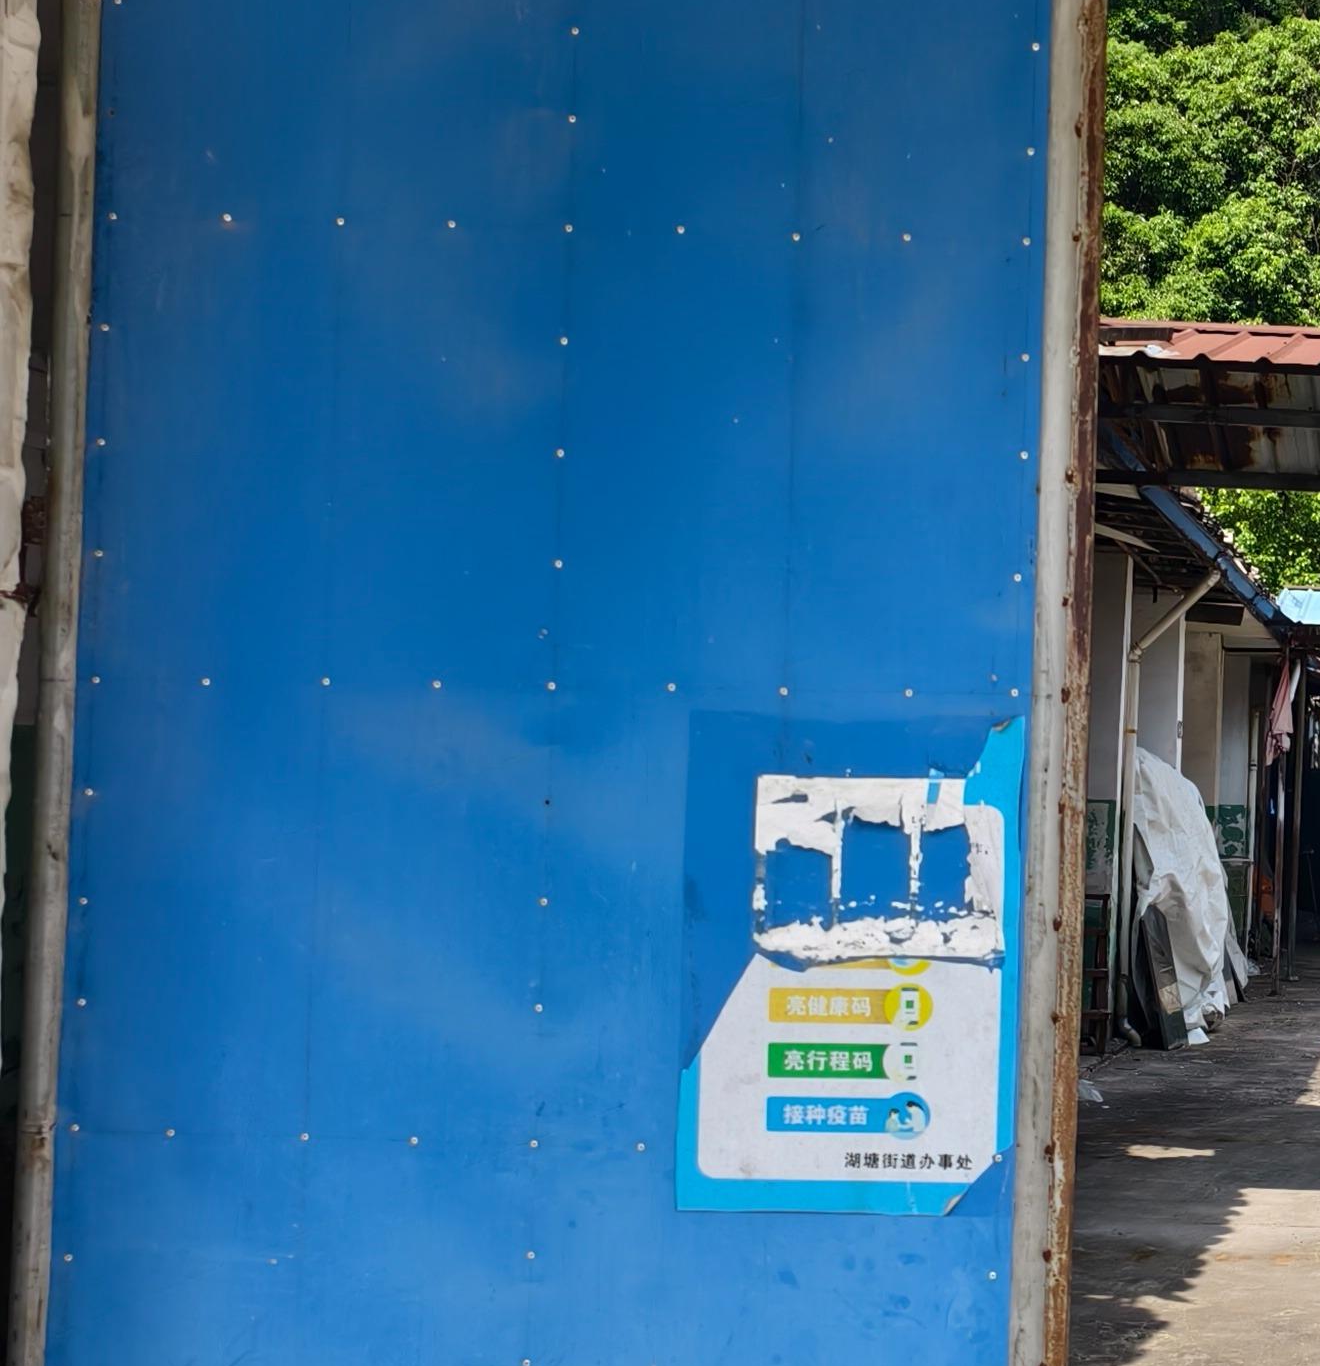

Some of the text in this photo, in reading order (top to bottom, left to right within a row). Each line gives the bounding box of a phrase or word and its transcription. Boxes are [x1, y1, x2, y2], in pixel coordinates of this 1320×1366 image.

[786, 994, 872, 1018] 亮健康码
[783, 1049, 874, 1073] 亮行程码
[782, 1105, 869, 1126] 接种疫苗
[844, 1152, 973, 1170] 湖塘街道办事处
